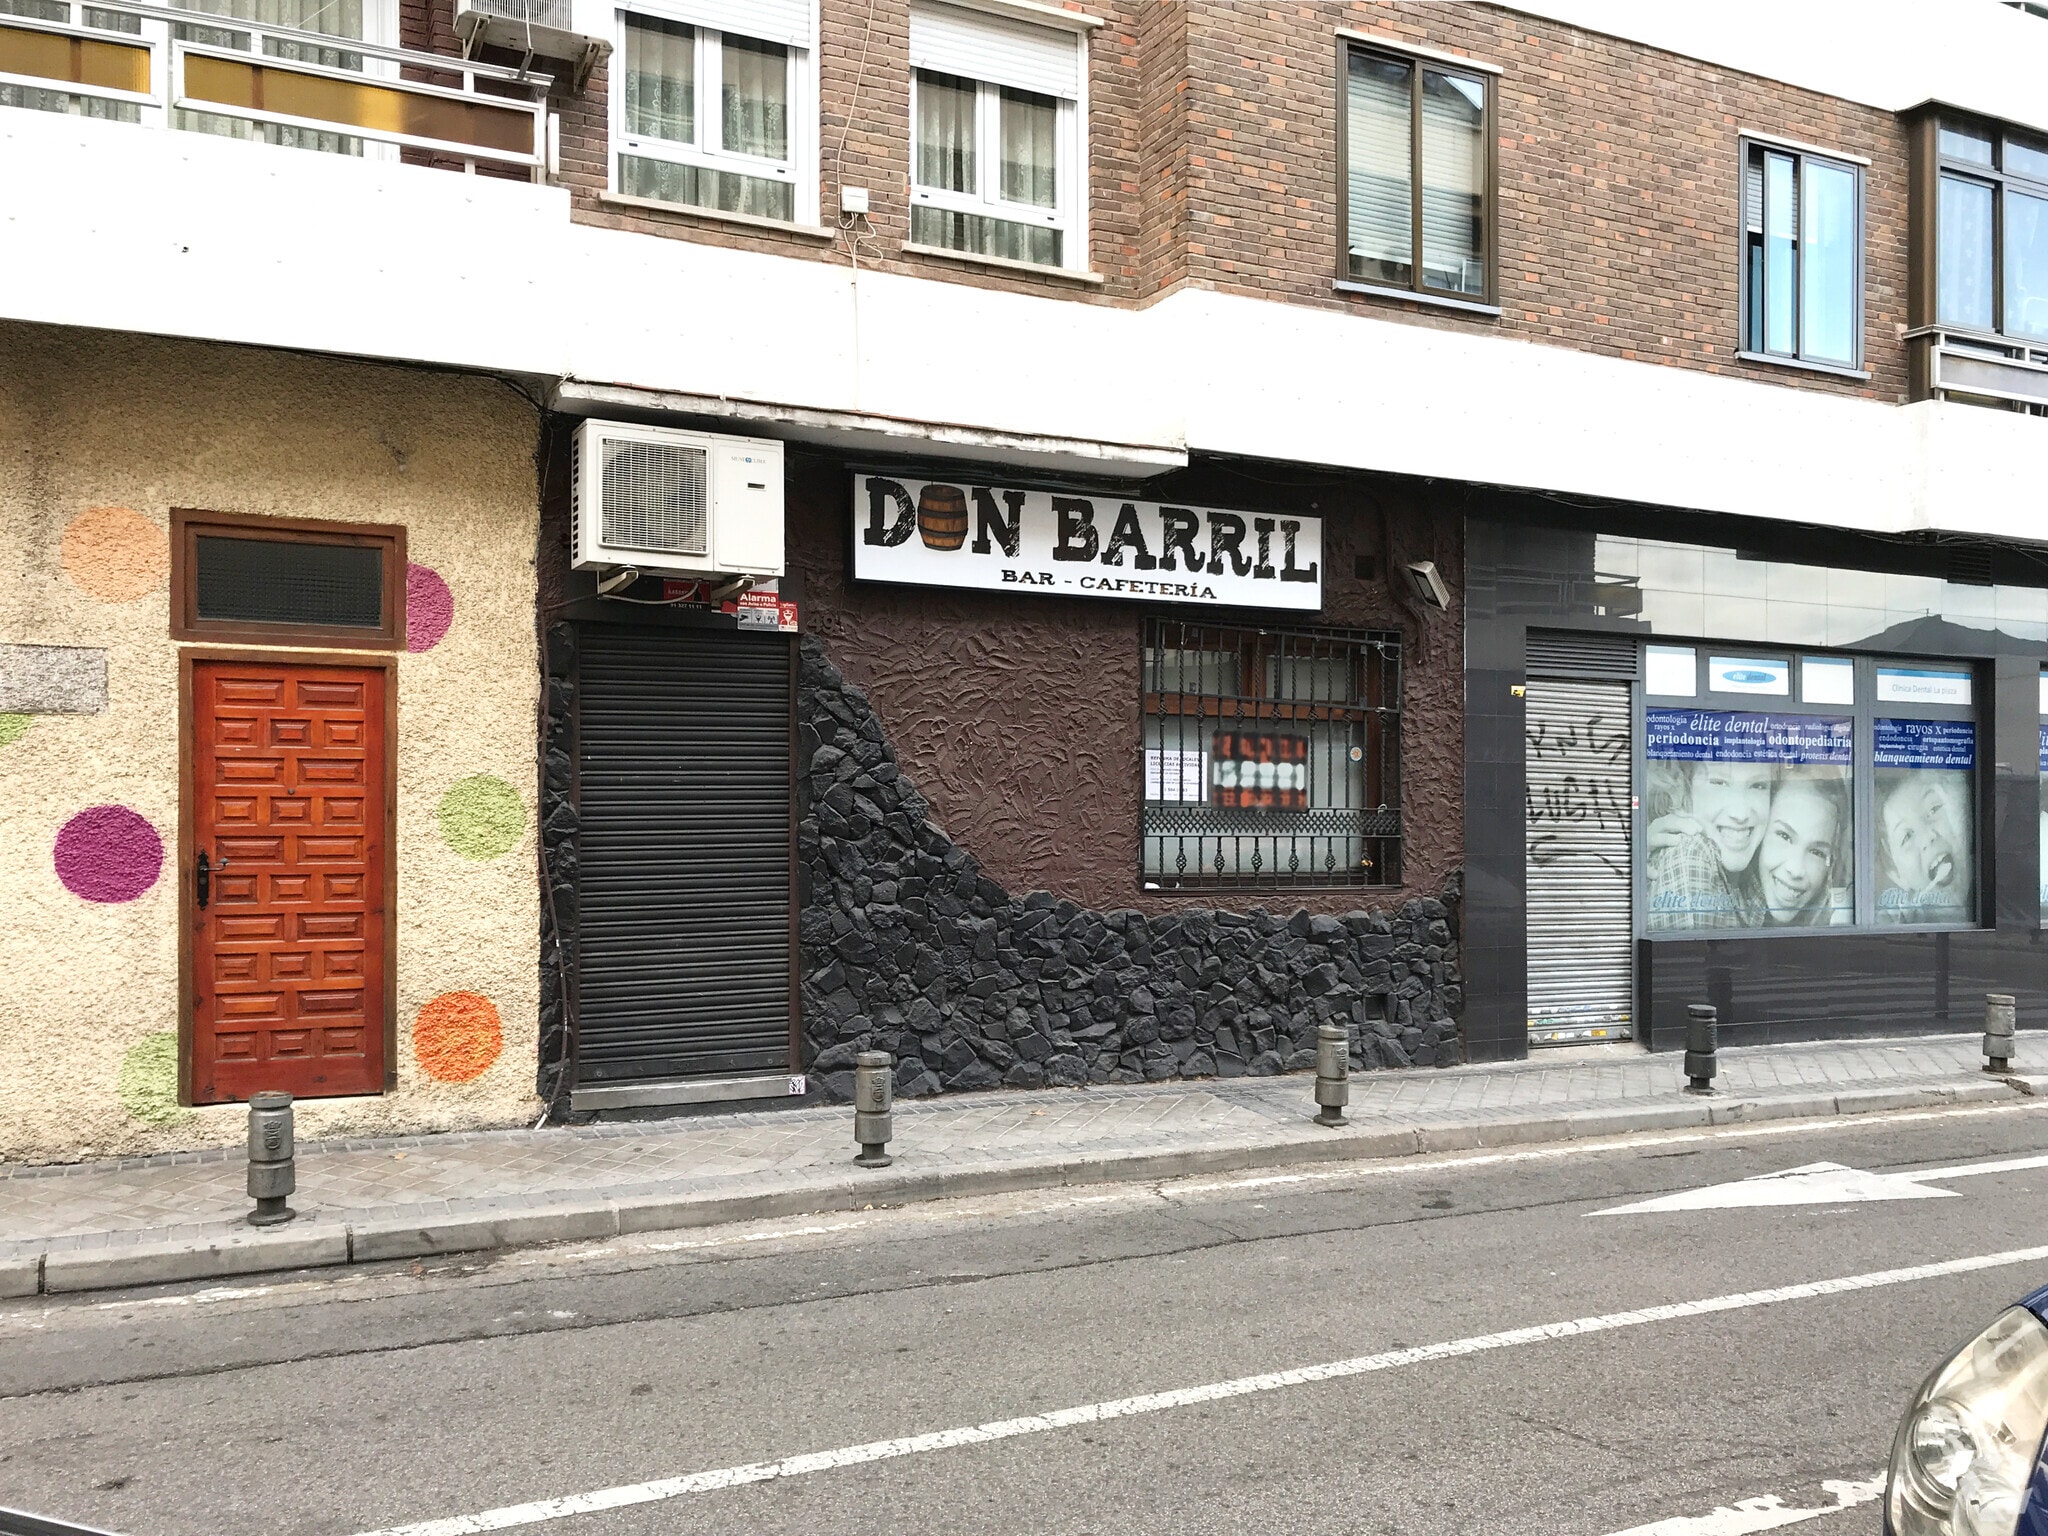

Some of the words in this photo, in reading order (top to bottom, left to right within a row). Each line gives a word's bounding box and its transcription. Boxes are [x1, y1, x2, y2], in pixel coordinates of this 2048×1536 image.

[1052, 496, 1318, 584] BARRIL
[1001, 569, 1056, 586] BAR
[1079, 576, 1218, 600] CAFETERÍA
[740, 593, 777, 603] Alarma
[1654, 724, 1670, 732] rayos
[1690, 713, 1722, 732] élite
[1724, 715, 1769, 734] dental
[1905, 724, 1934, 737] rayos
[1935, 726, 1942, 735] x
[1943, 727, 1973, 735] periodoncia
[1648, 732, 1720, 747] periodoncia
[1879, 734, 1913, 743] endodoncia
[1695, 750, 1713, 759] dental
[1715, 749, 1752, 758] endodoncia
[1829, 752, 1852, 761] dental
[1874, 751, 1944, 766] blanqueamiento
[1945, 753, 1973, 765] dental
